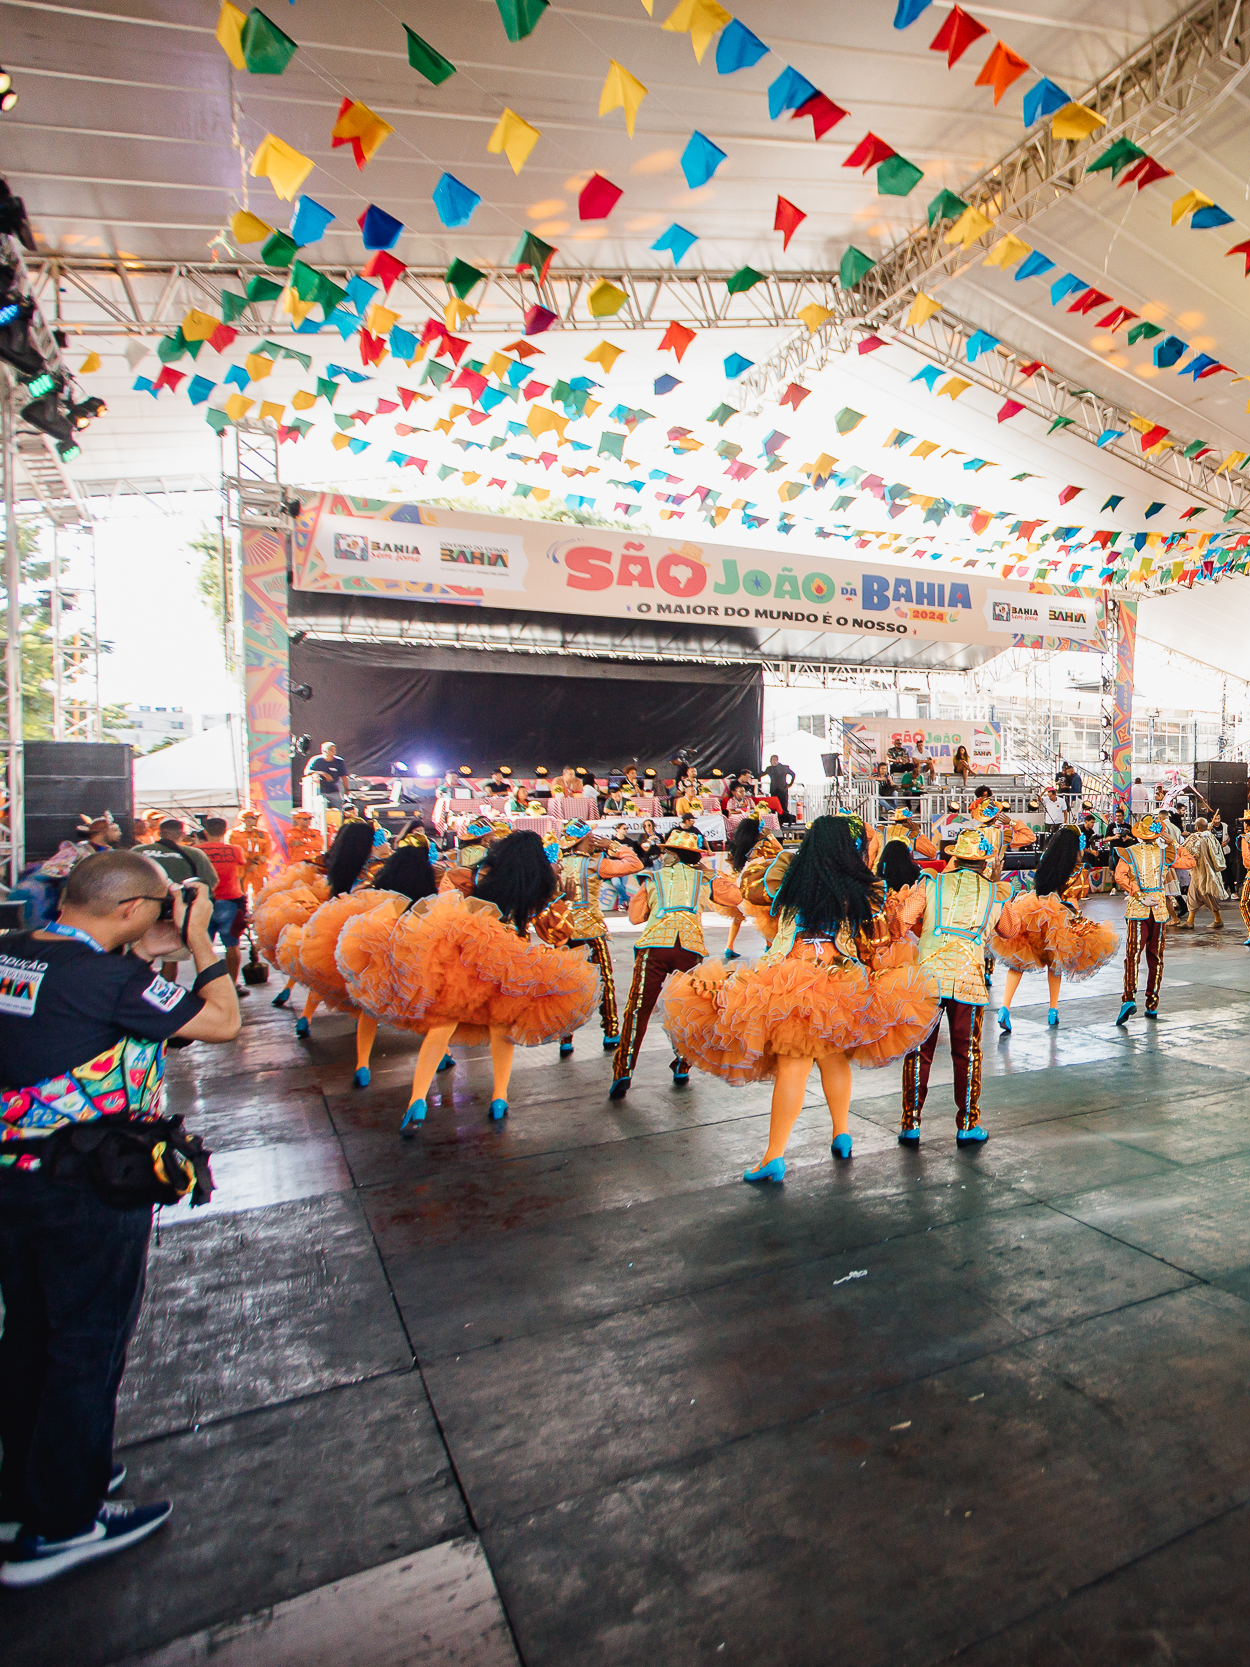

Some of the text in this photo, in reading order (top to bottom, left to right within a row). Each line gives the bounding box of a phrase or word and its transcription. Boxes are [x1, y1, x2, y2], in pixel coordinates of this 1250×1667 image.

[371, 541, 421, 555] BAHIA
[440, 548, 509, 568] BAHIA
[565, 541, 707, 597] SÃO
[841, 586, 857, 597] DA
[862, 573, 972, 611] BAHIA
[637, 603, 908, 634] O MAIOR DO MUNDO É O NOSSO
[912, 609, 944, 621] 2024
[1011, 607, 1038, 616] BAHIA
[1049, 609, 1086, 623] BAHIA
